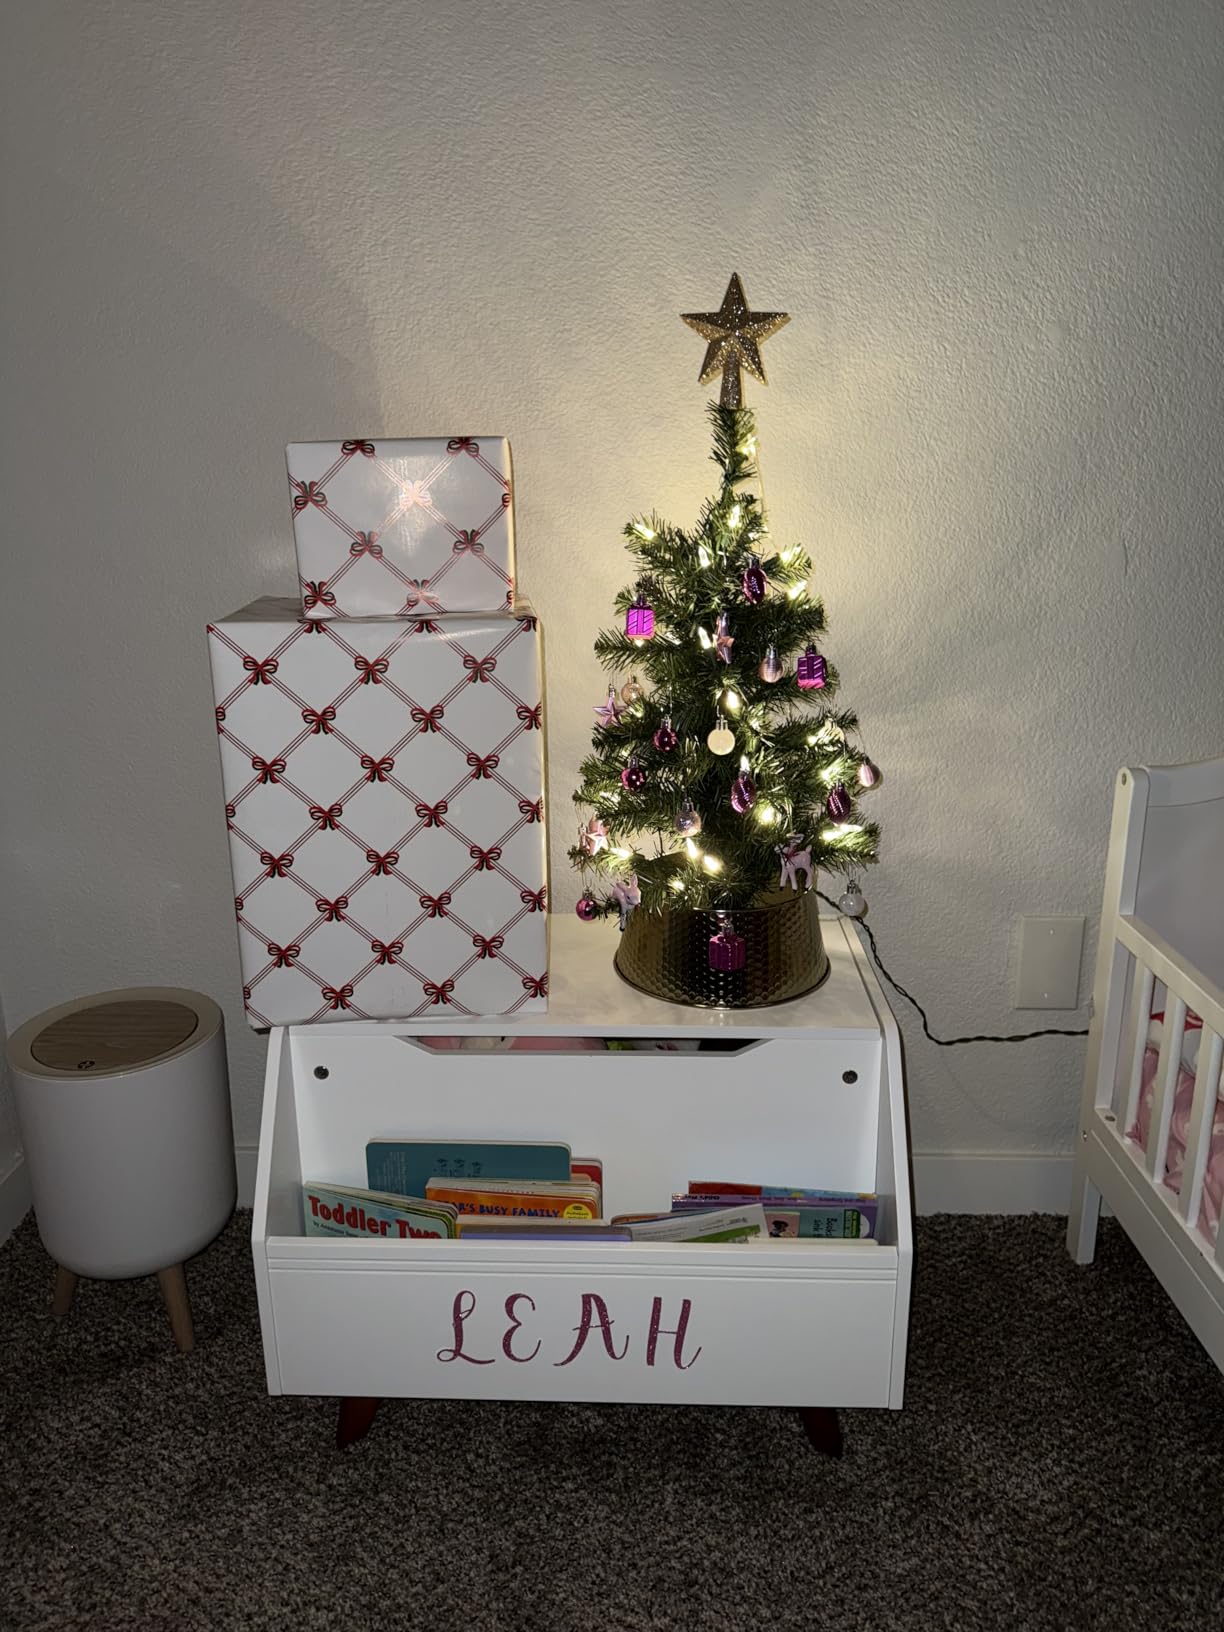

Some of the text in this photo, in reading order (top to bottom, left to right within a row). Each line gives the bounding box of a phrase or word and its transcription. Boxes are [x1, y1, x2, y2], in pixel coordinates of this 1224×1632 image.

[308, 1195, 391, 1236] Toddler
[479, 1204, 508, 1216] BUSY
[512, 1207, 560, 1217] FAMILY
[437, 1290, 702, 1370] LEAH
